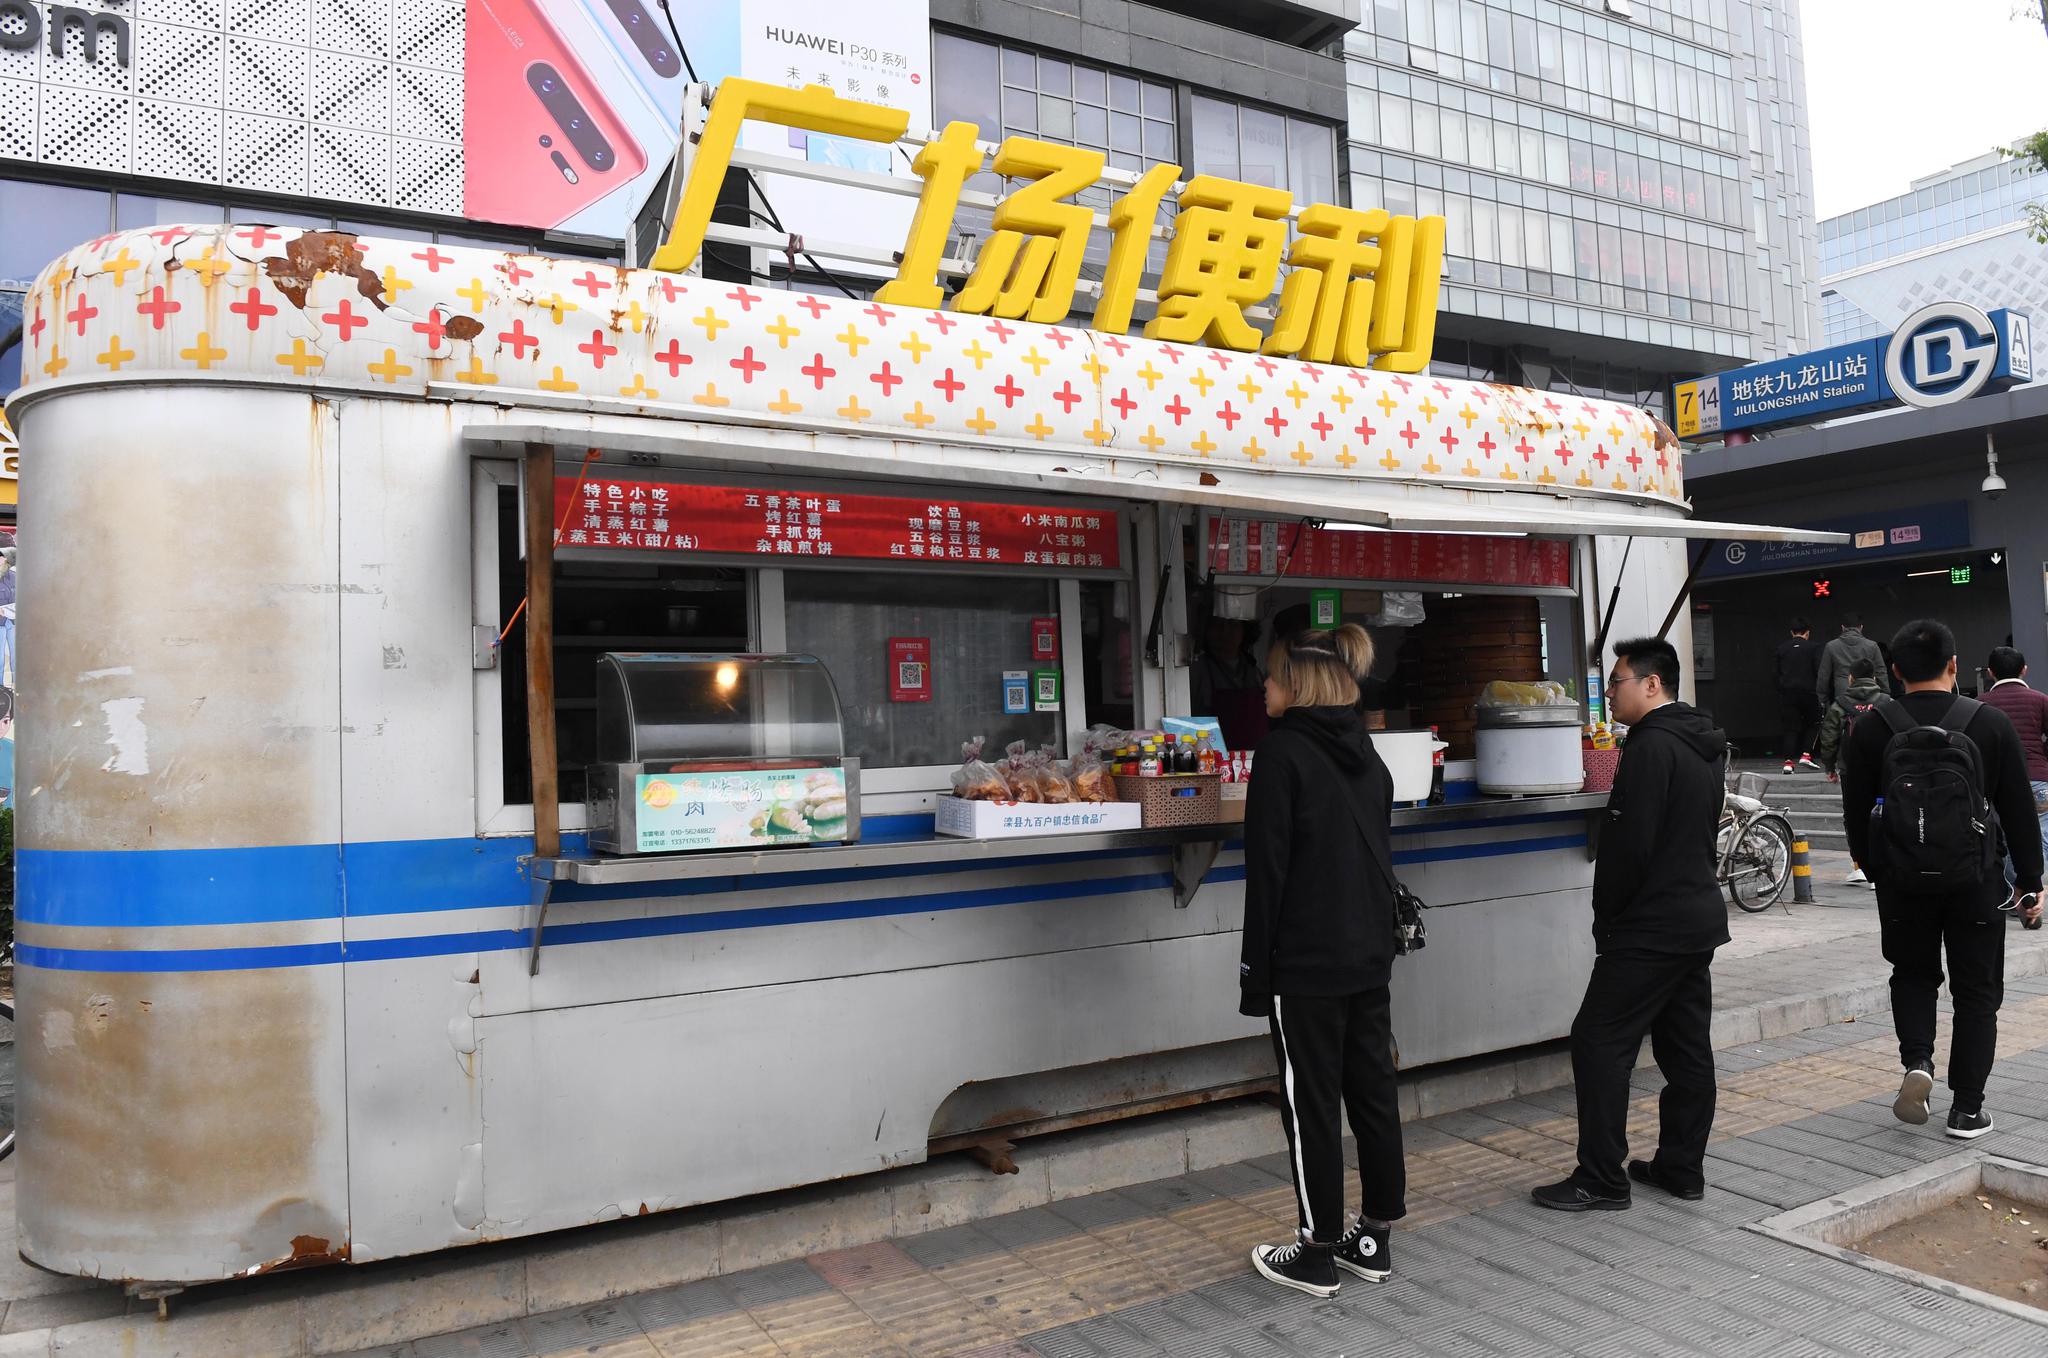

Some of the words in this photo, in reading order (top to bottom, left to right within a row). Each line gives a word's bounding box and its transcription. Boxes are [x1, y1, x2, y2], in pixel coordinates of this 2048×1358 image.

[766, 25, 844, 56] HUAWEI
[850, 44, 878, 63] P30
[882, 51, 907, 69] 系列
[786, 66, 890, 99] 未来影像
[650, 76, 1446, 374] 广场便利
[2012, 320, 2026, 355] A
[1731, 353, 1868, 402] 地铁九龙山站
[1680, 391, 1694, 415] 7
[1698, 387, 1719, 411] 14
[1734, 390, 1819, 417] JIULONGSHAN
[1822, 382, 1865, 400] Station
[583, 482, 669, 502] 特色小吃
[583, 500, 669, 517] 手工粽子
[744, 494, 841, 513] 五香茶叶蛋
[927, 505, 961, 519] 饮品
[583, 515, 669, 533] 清蒸红薯
[765, 510, 822, 526] 烤红薯
[908, 517, 981, 533] 现磨豆浆
[1021, 513, 1101, 530] 小米南瓜粥
[765, 525, 823, 541] 手抓饼
[909, 531, 981, 546] 五谷豆浆
[1039, 533, 1086, 548] 八宝粥
[756, 539, 833, 556] 杂粮煎饼
[890, 543, 1001, 560] 红枣枸杞豆浆
[1761, 549, 1811, 561] JIULONGSHAN
[1023, 551, 1103, 567] 皮蛋瘦肉粥
[684, 800, 705, 817] 肉
